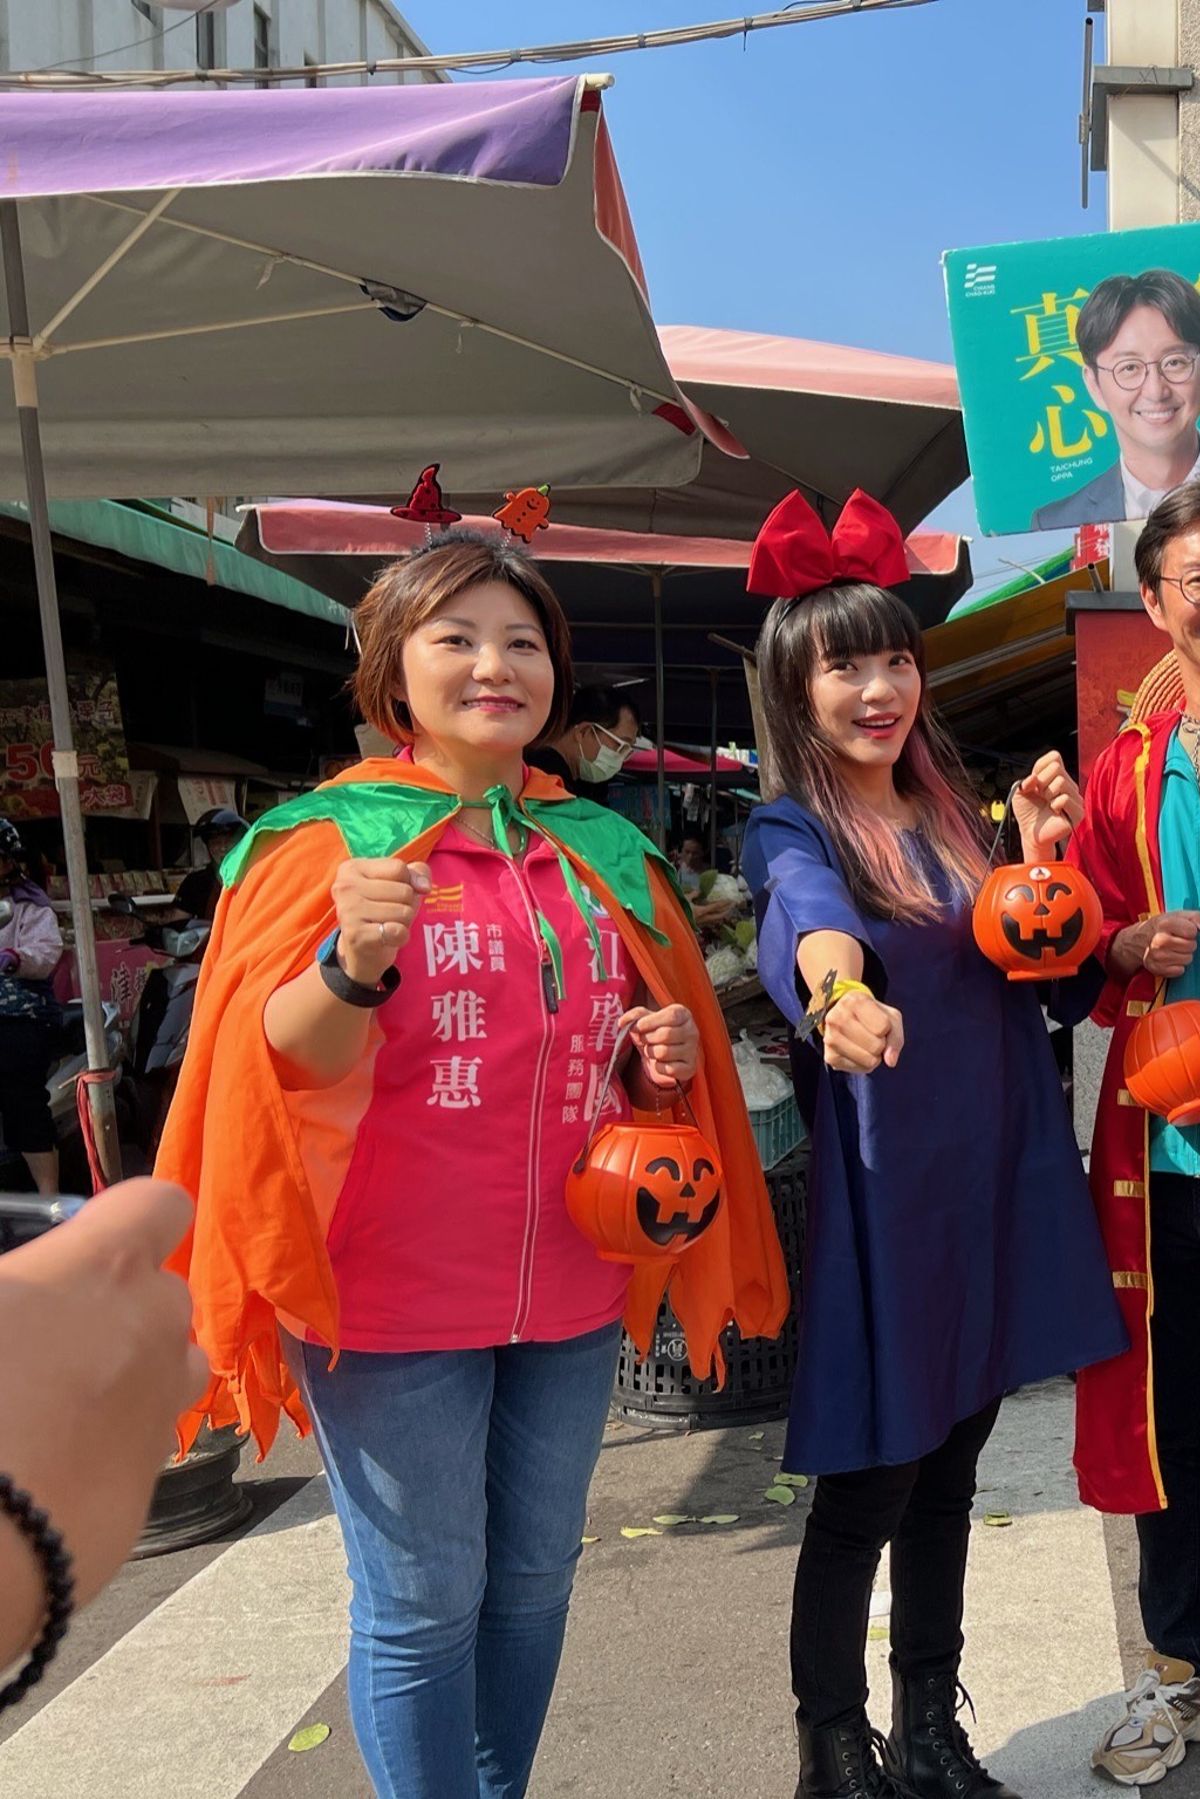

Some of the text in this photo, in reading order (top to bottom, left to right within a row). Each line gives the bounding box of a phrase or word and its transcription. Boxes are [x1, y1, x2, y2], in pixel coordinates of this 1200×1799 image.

[1050, 456, 1094, 473] TAICHUNG
[1050, 471, 1074, 483] OPPA
[486, 923, 507, 973] 市議員
[423, 921, 488, 1109] 陳雅惠
